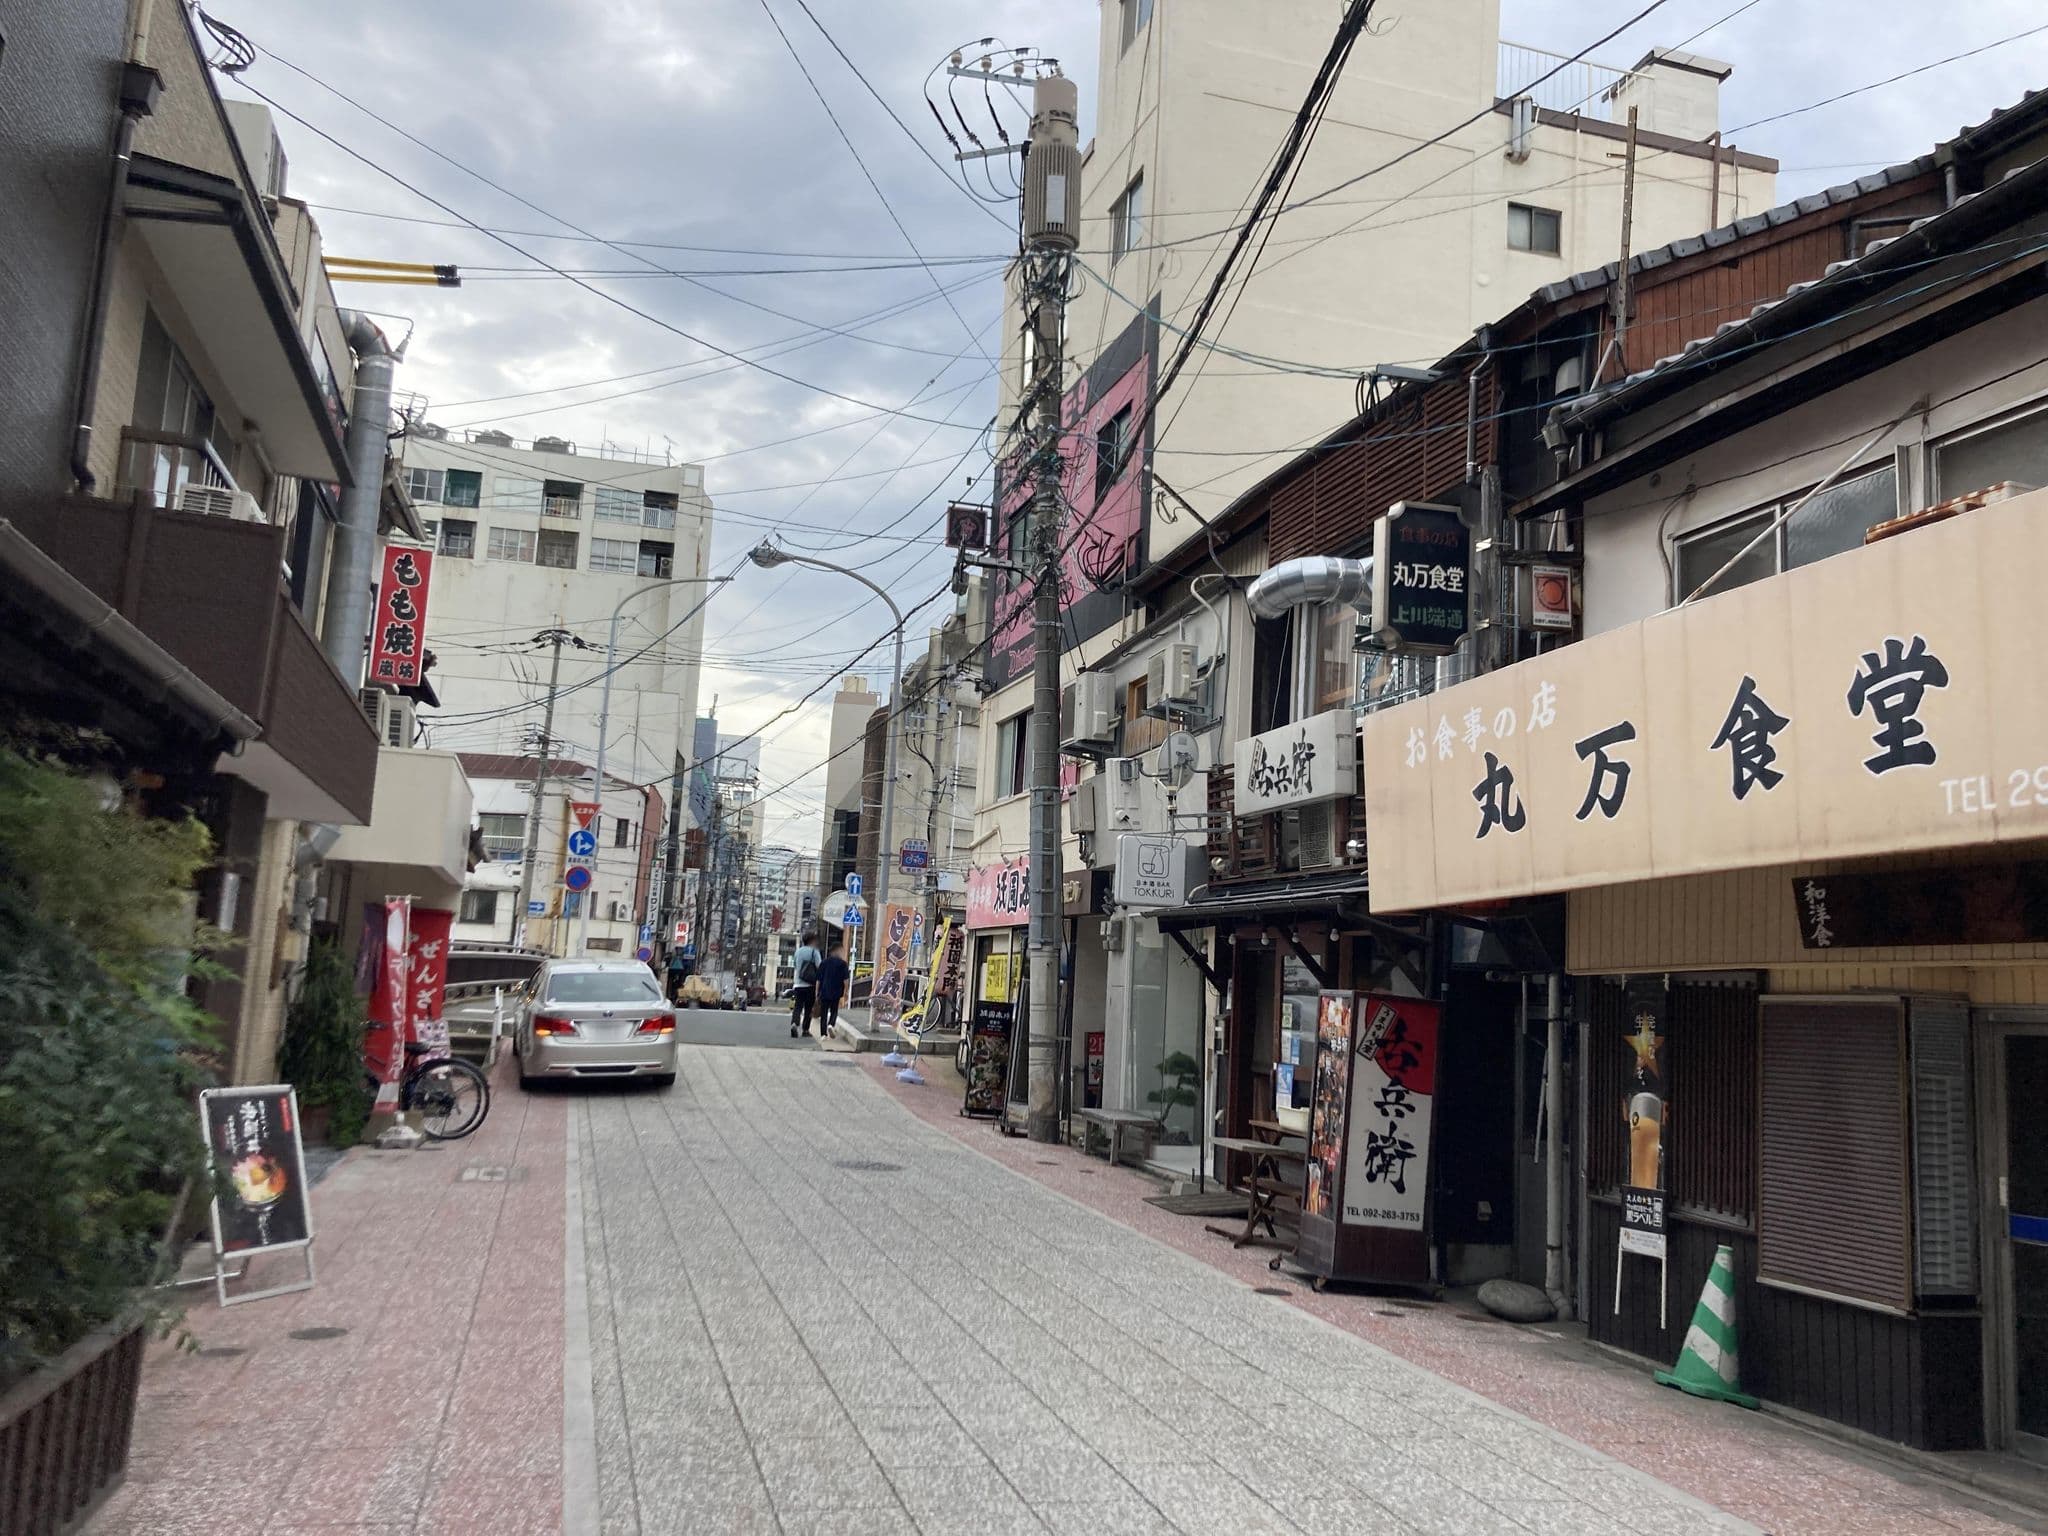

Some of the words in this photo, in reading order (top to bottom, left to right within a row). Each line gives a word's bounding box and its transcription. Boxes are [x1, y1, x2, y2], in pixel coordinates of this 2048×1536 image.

[1392, 561, 1465, 593] 丸万食堂
[382, 553, 422, 656] もも焼
[1392, 604, 1464, 629] 上川端通
[1405, 680, 1557, 768] お食事の店
[1472, 634, 1950, 841] 丸万食堂
[1939, 775, 1998, 815] TEL
[2007, 765, 2048, 807] 29
[1133, 887, 1175, 899] TOKKURI
[1804, 880, 1834, 947] 和洋食
[1346, 1206, 1361, 1217] TEL
[1362, 1207, 1420, 1222] 092-263-3753
